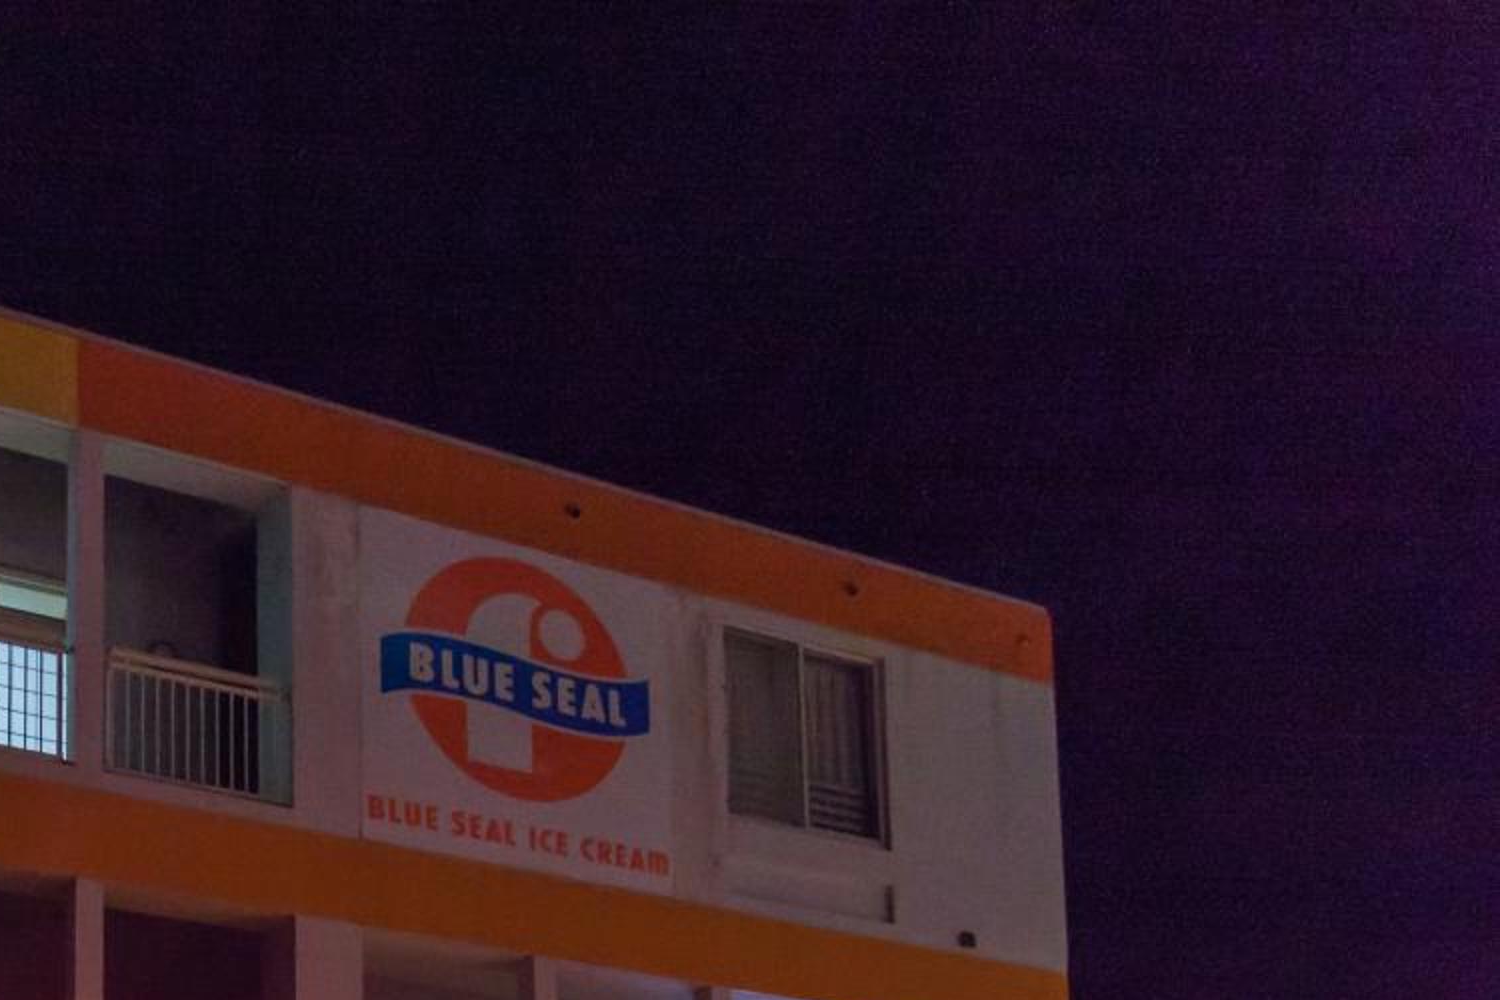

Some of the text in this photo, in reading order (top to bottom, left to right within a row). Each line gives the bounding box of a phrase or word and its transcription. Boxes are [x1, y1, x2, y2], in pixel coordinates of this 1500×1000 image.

[408, 640, 627, 728] BLUE SEAL
[367, 794, 439, 832] BLUE
[451, 809, 517, 847] SEAL
[529, 826, 569, 858] ICE
